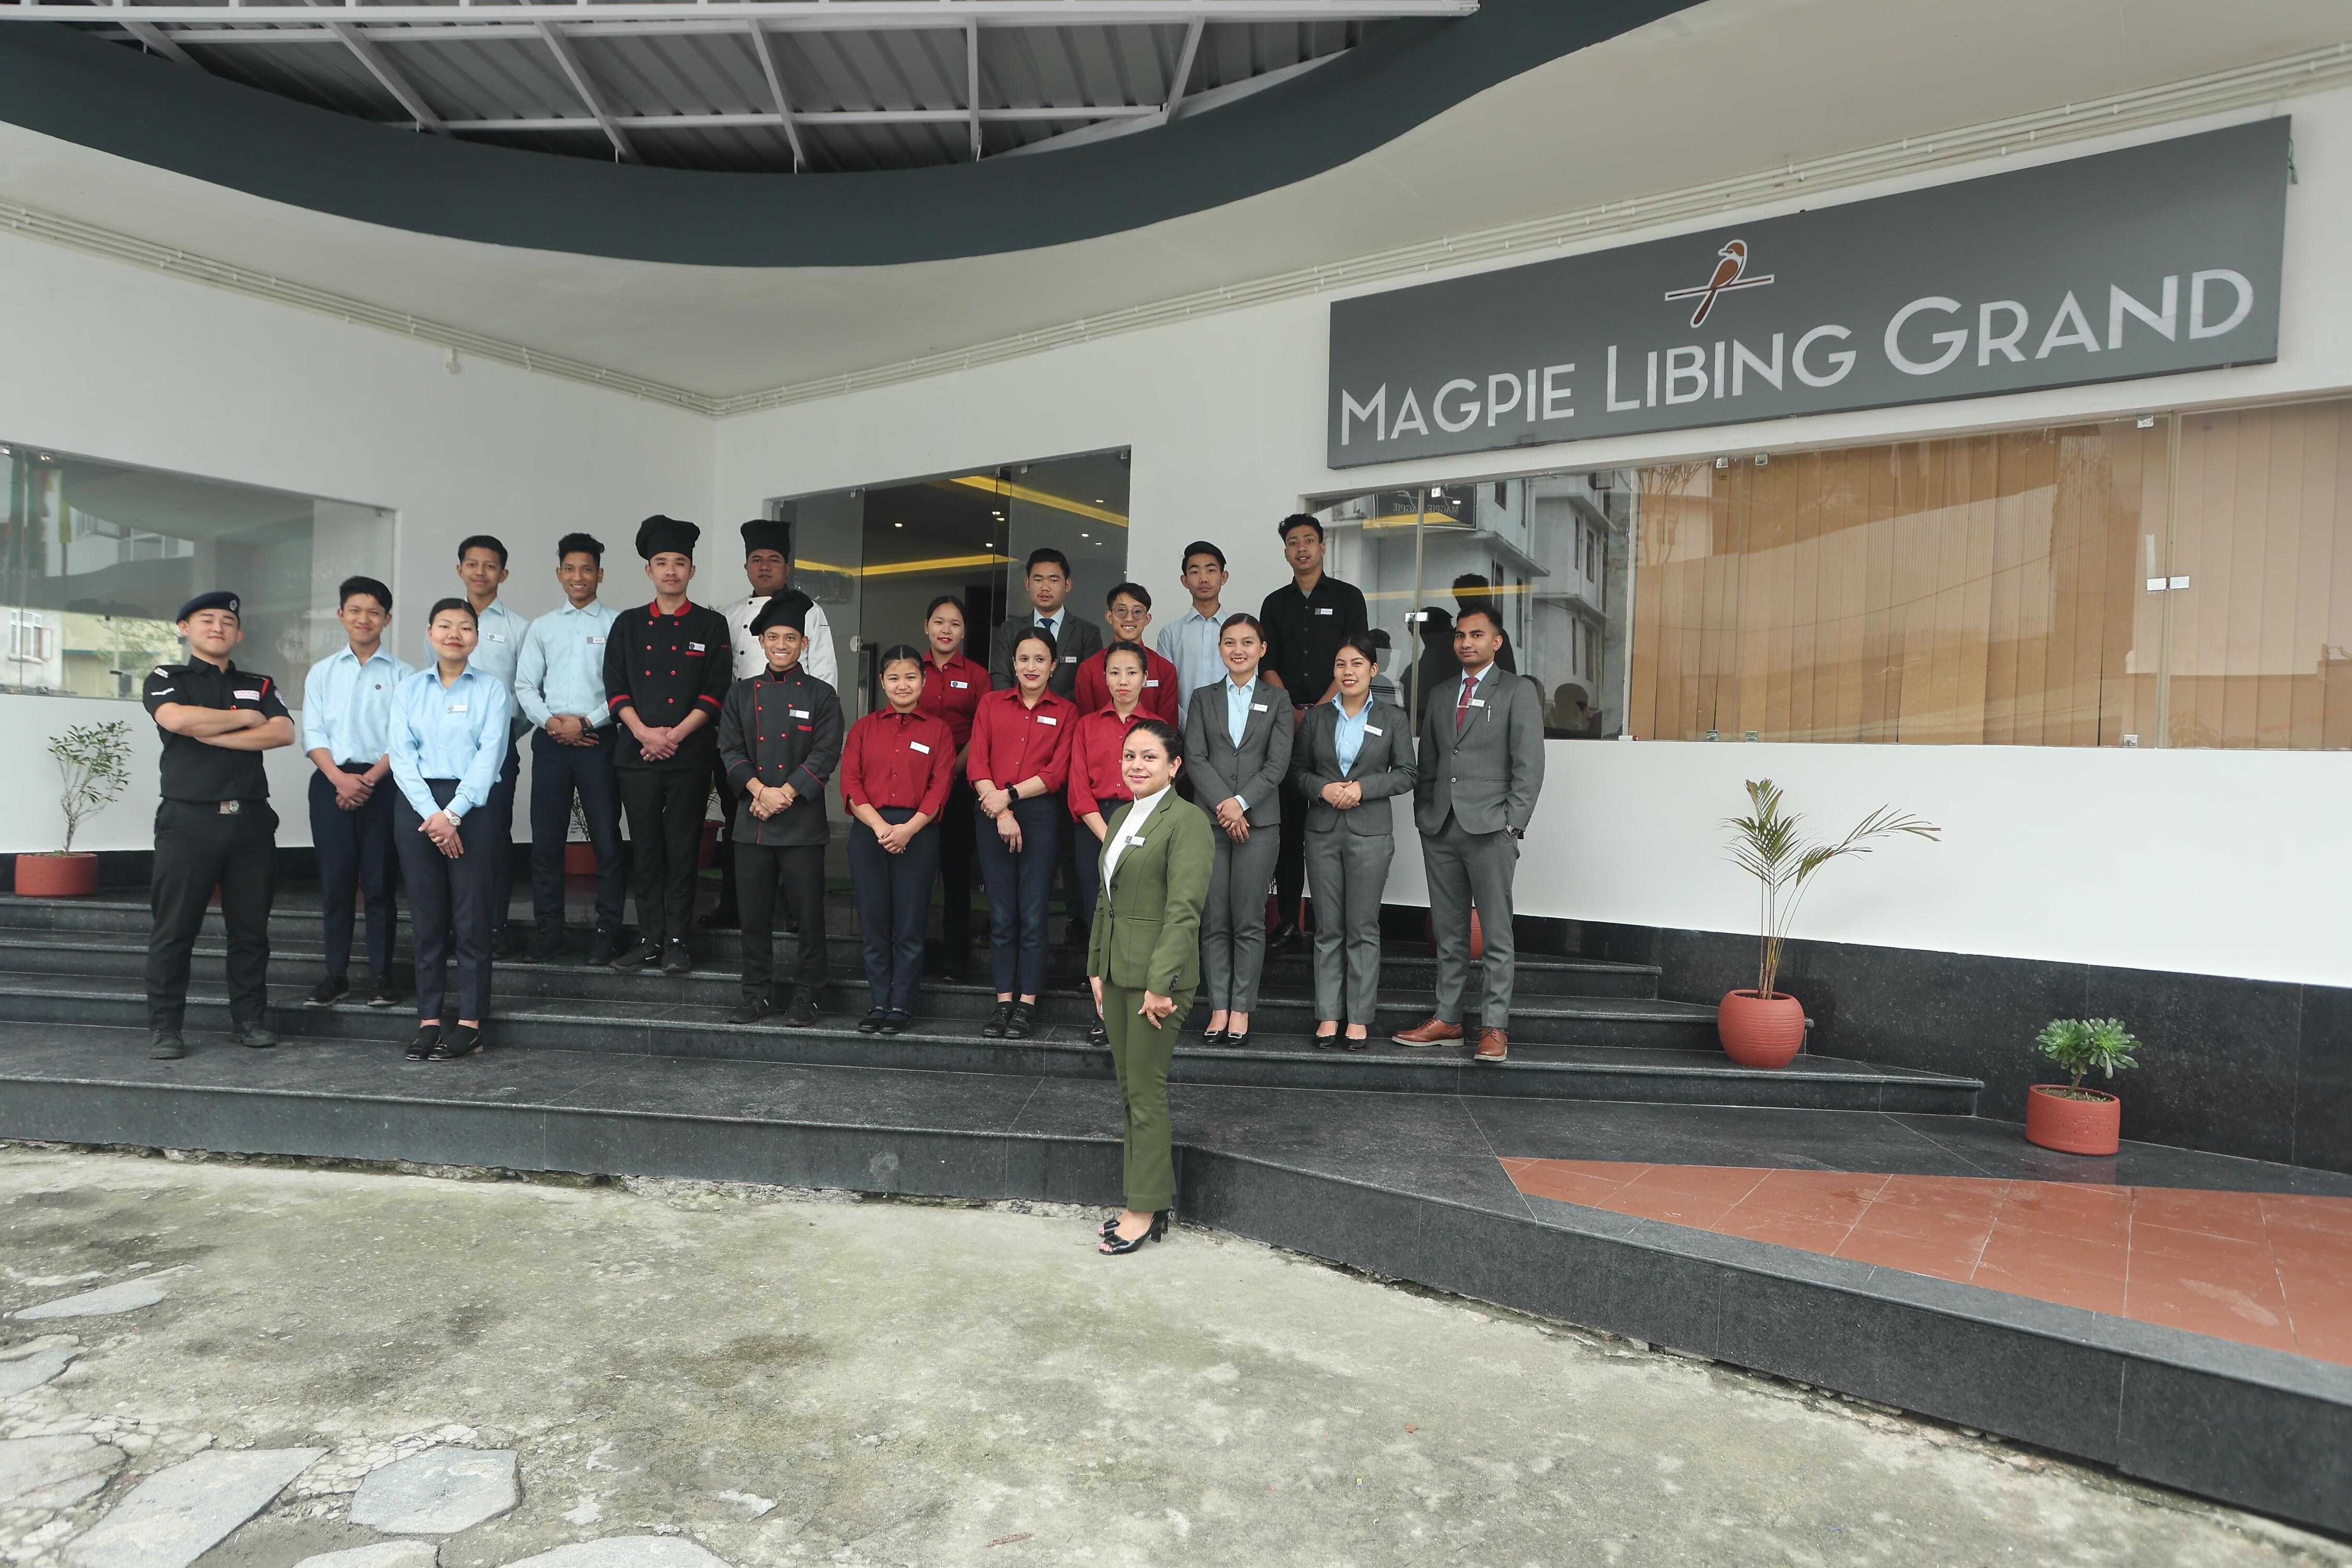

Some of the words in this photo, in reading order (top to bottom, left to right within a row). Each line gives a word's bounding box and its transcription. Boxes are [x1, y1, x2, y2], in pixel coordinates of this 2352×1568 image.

[1341, 363, 1575, 446] MAGPIE
[1606, 324, 1857, 413] LIBING
[1883, 268, 2254, 376] GRAND
